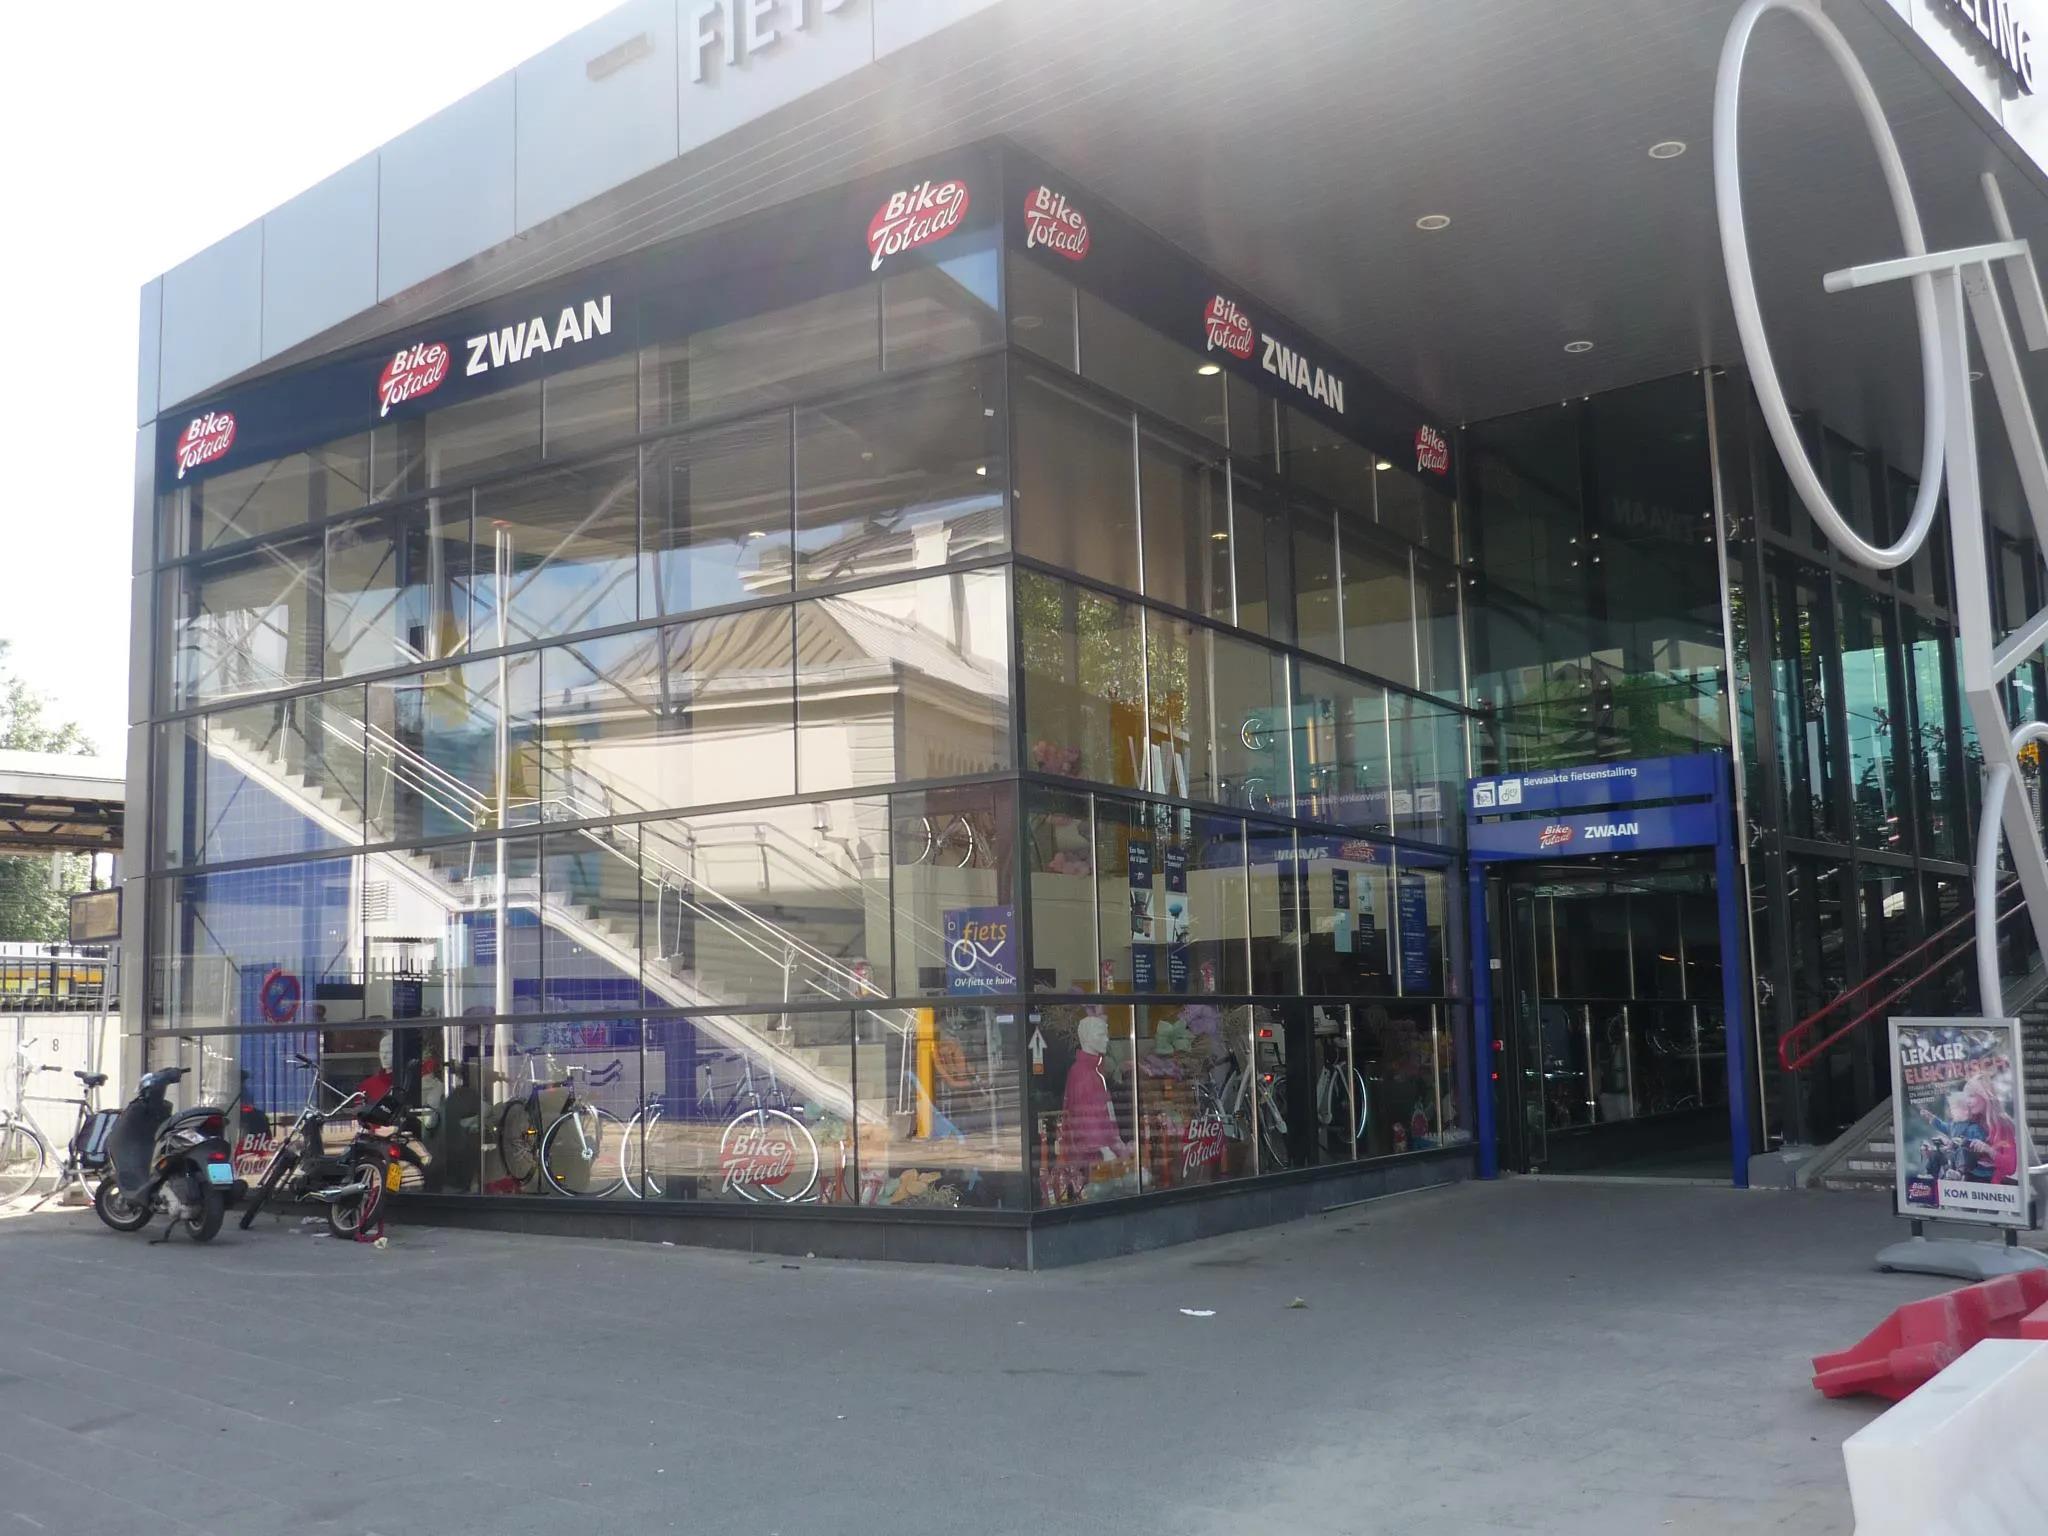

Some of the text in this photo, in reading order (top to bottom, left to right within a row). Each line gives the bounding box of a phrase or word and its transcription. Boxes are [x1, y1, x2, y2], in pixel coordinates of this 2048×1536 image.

[690, 0, 848, 83] FIE
[884, 181, 956, 221] Bike
[1036, 185, 1082, 229] Bike
[871, 189, 963, 271] Totaal
[1027, 210, 1087, 254] Totaal
[1213, 295, 1248, 331] Bike
[466, 295, 612, 376] ZWAAN
[1207, 317, 1252, 352] Totaal
[391, 342, 441, 375] Bike
[1261, 332, 1344, 414] ZWAAN
[380, 350, 447, 417] Totaal
[187, 412, 229, 441] Bike
[1421, 424, 1444, 452] Bike
[178, 420, 234, 479] Totaal
[1417, 444, 1447, 472] Totaal
[1523, 767, 1637, 787] Bewaakte fietsenstalling
[1545, 825, 1569, 835] Bike
[1584, 822, 1639, 839] ZWAAN
[963, 921, 1007, 954] fiets
[52, 1038, 60, 1052] 8
[1901, 1040, 1966, 1066] LEKKER
[243, 1132, 279, 1151] Bike
[1188, 1113, 1219, 1139] Bike
[733, 1133, 786, 1157] Bike
[1183, 1128, 1223, 1178] Totaal
[236, 1152, 270, 1180] Tota
[722, 1150, 792, 1193] Totaal
[1944, 1189, 2015, 1203] KOM BINNEN!
